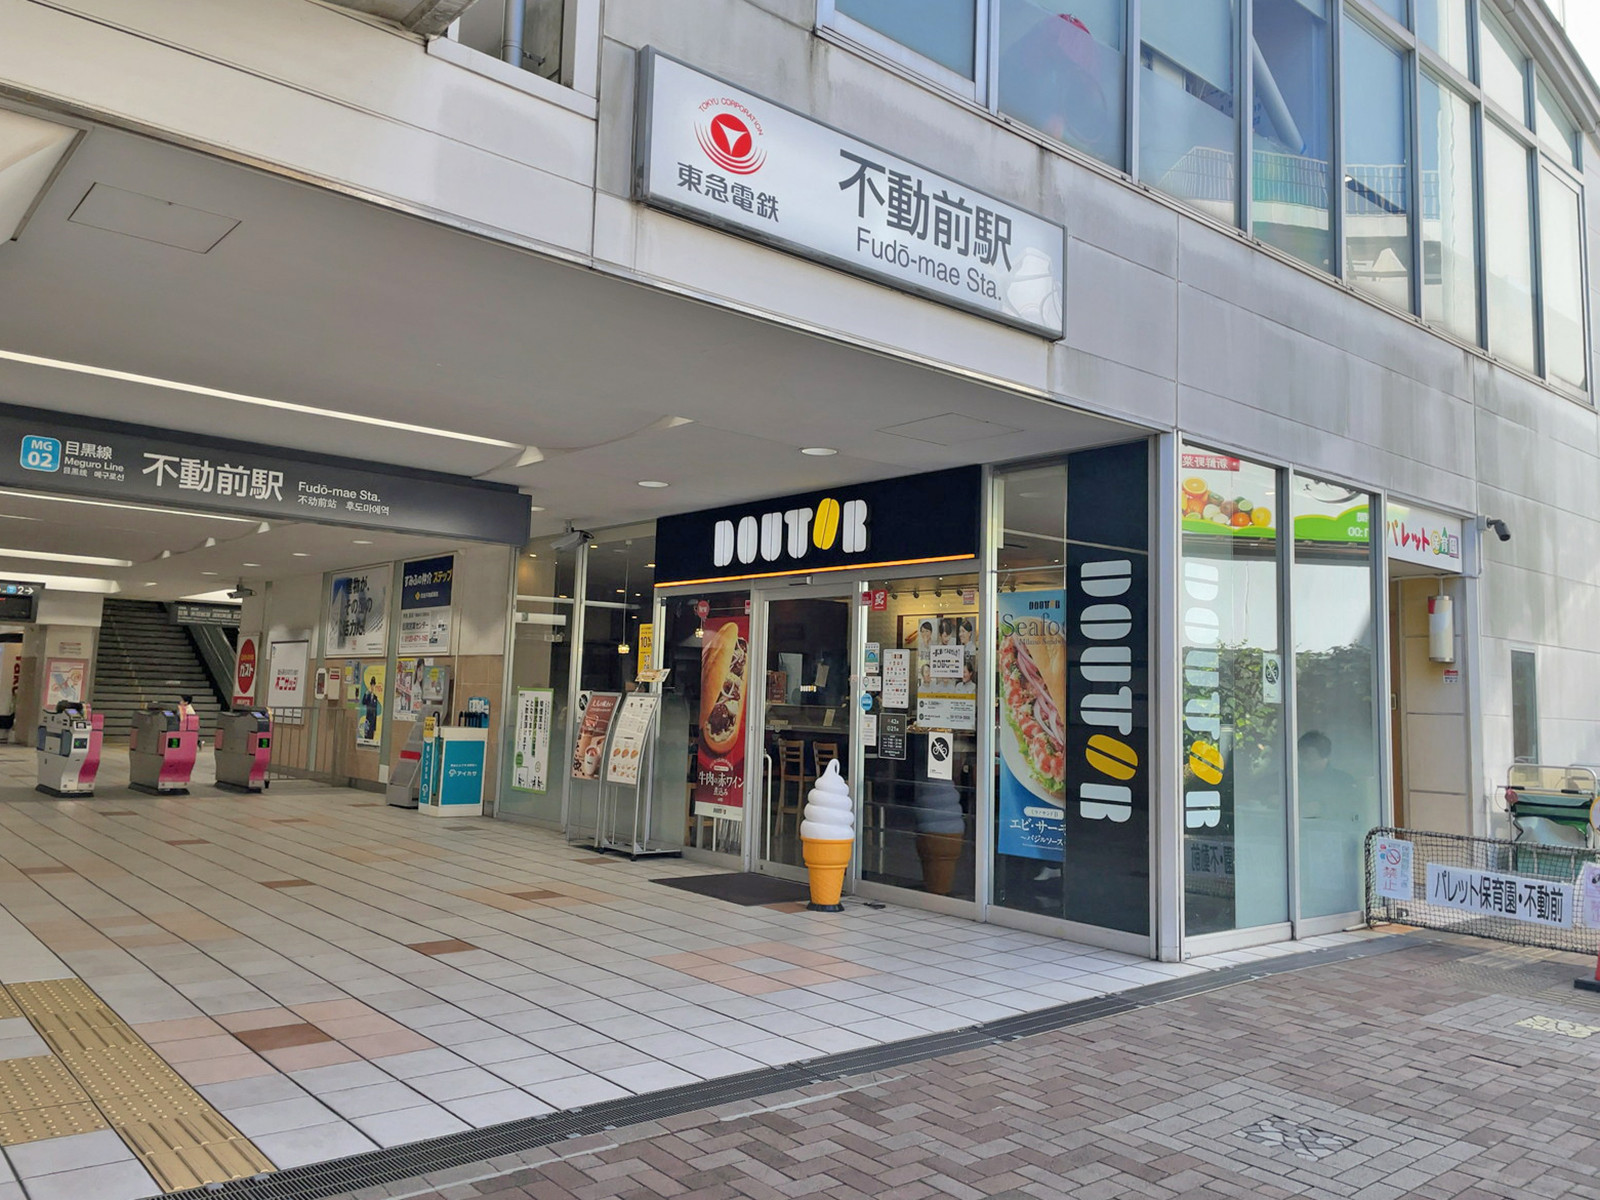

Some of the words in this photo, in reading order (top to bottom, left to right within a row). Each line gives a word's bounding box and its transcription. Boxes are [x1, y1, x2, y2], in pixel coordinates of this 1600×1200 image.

[698, 98, 719, 112] TOKYU
[721, 97, 764, 136] CORPORATION
[677, 162, 780, 223] 東急電鉄
[839, 148, 1013, 273] 不動前駅
[857, 226, 960, 286] Fudō-mae
[966, 267, 1002, 301] Sta.
[27, 451, 53, 468] 02
[31, 440, 53, 451] MG
[64, 457, 102, 469] Meguro
[104, 462, 124, 472] Line
[65, 441, 113, 460] 目黒線
[142, 452, 285, 503] 不動前駅
[298, 481, 357, 499] Fudō-mae
[359, 489, 381, 502] Sta.
[713, 497, 867, 567] DOUTOR
[1002, 612, 1066, 637] Seafo
[1079, 559, 1139, 824] DOUTOR
[1184, 562, 1225, 829] DOUTOR
[1434, 870, 1564, 923] パレット保育園・不動前
